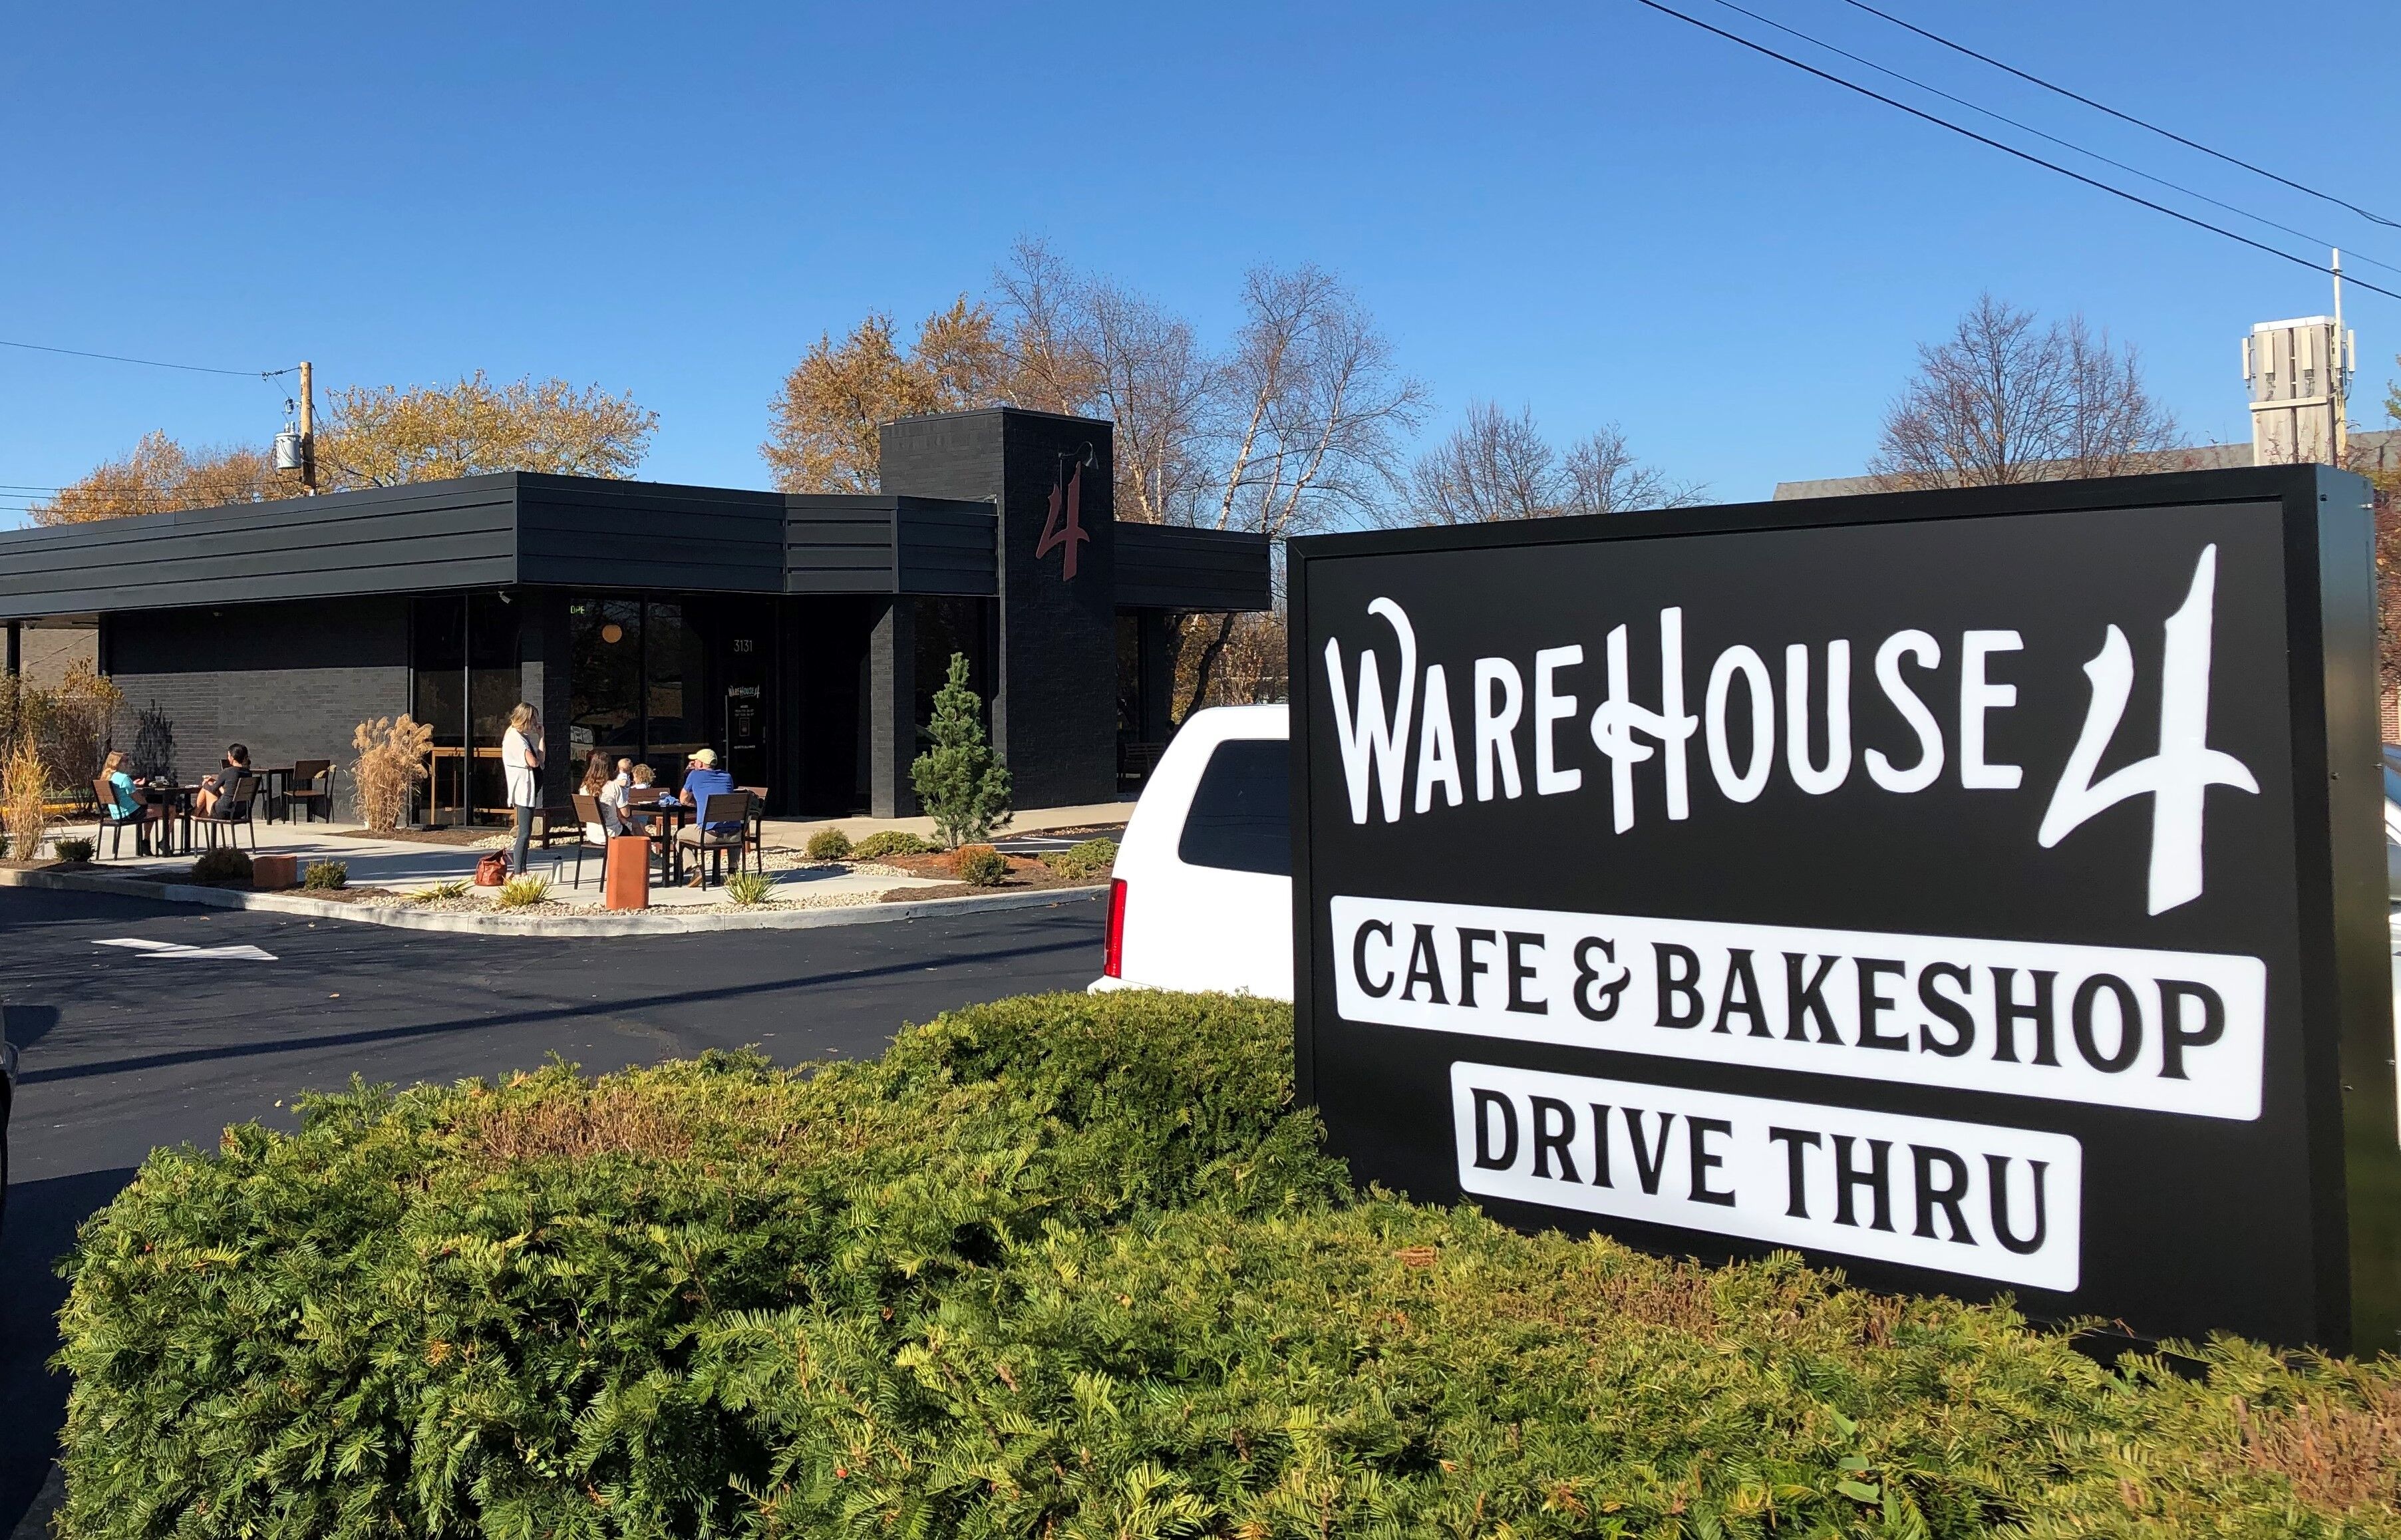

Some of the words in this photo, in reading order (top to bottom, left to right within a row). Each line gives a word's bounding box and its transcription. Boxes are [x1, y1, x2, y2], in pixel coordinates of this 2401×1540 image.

[1035, 460, 1090, 581] 4
[734, 639, 752, 653] 3131
[754, 683, 760, 699] 4
[2038, 543, 2261, 916] 4
[1353, 918, 1548, 1015] CAFE
[1573, 935, 1631, 1022] &
[1650, 941, 2225, 1081] BAKESHOP
[1470, 1087, 1736, 1207] DRIVE
[1768, 1126, 2050, 1255] THRU
